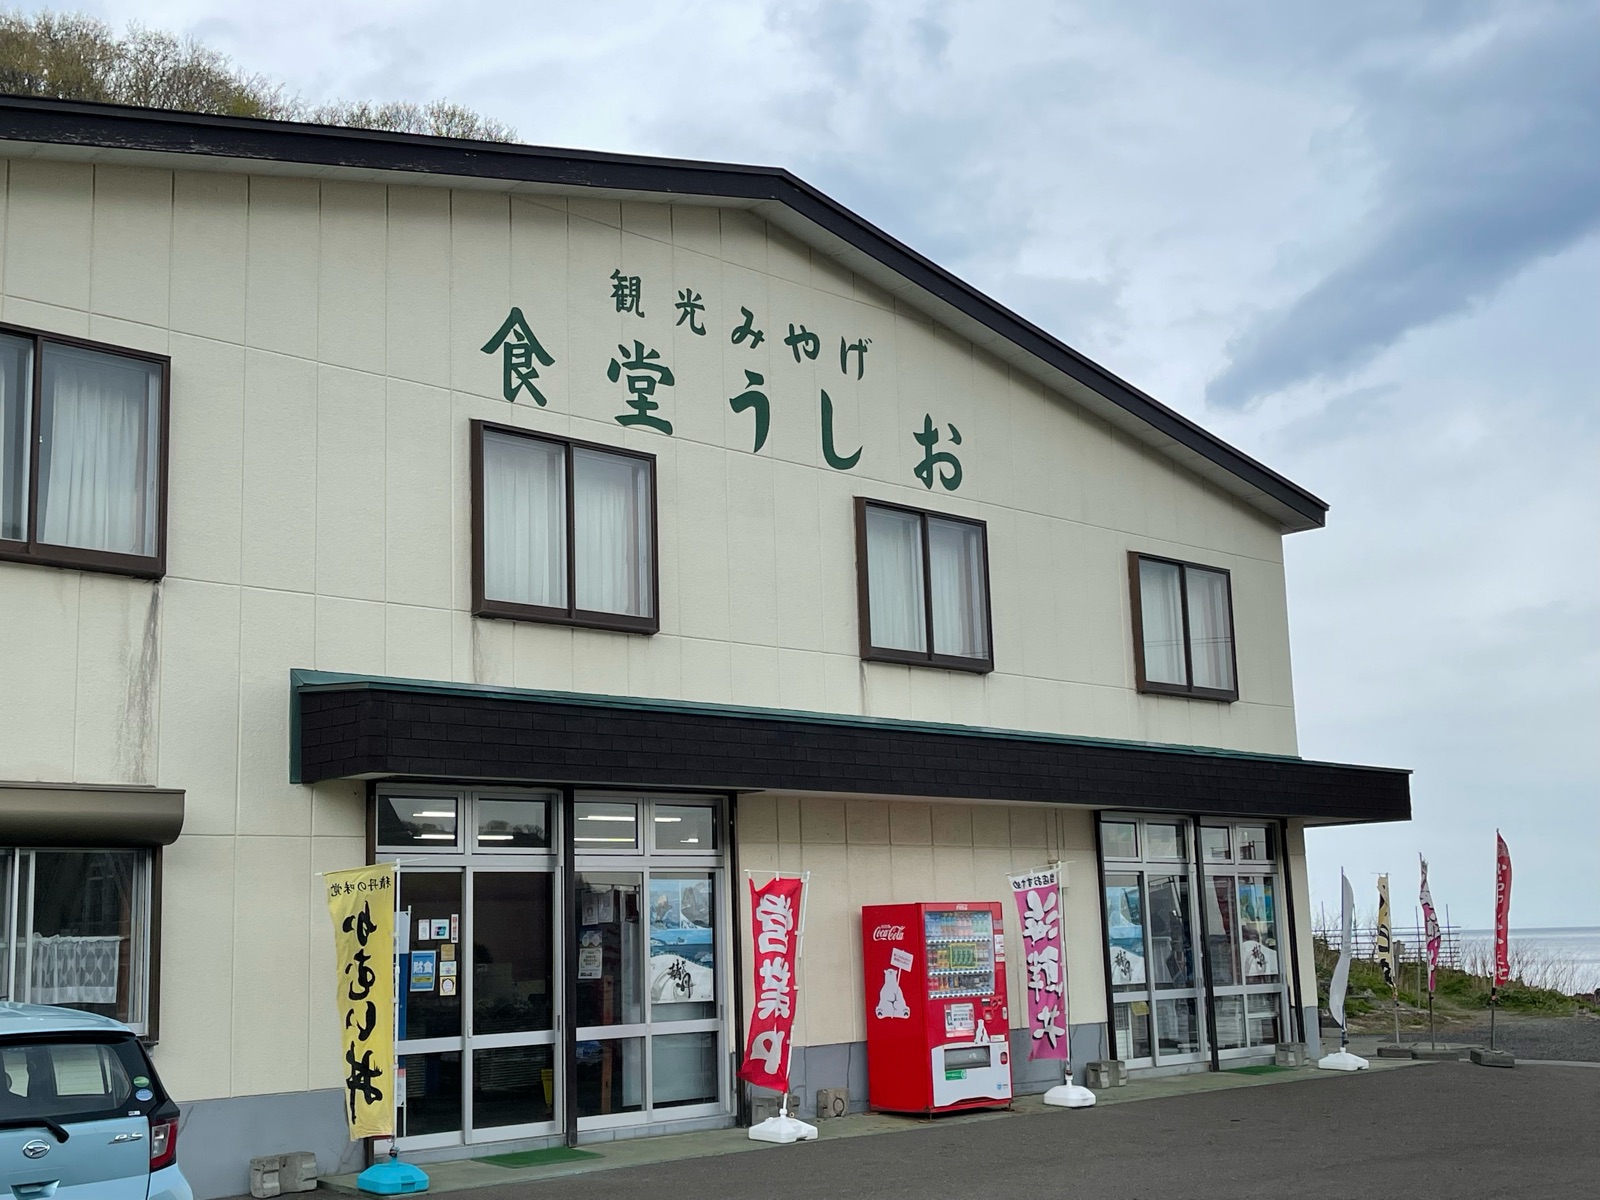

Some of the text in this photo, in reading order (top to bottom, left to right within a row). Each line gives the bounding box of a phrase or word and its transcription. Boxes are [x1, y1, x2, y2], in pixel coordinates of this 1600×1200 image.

[610, 269, 872, 381] 観光みやげ
[480, 306, 963, 491] 食堂うしお
[873, 925, 905, 941] Coca-Cola
